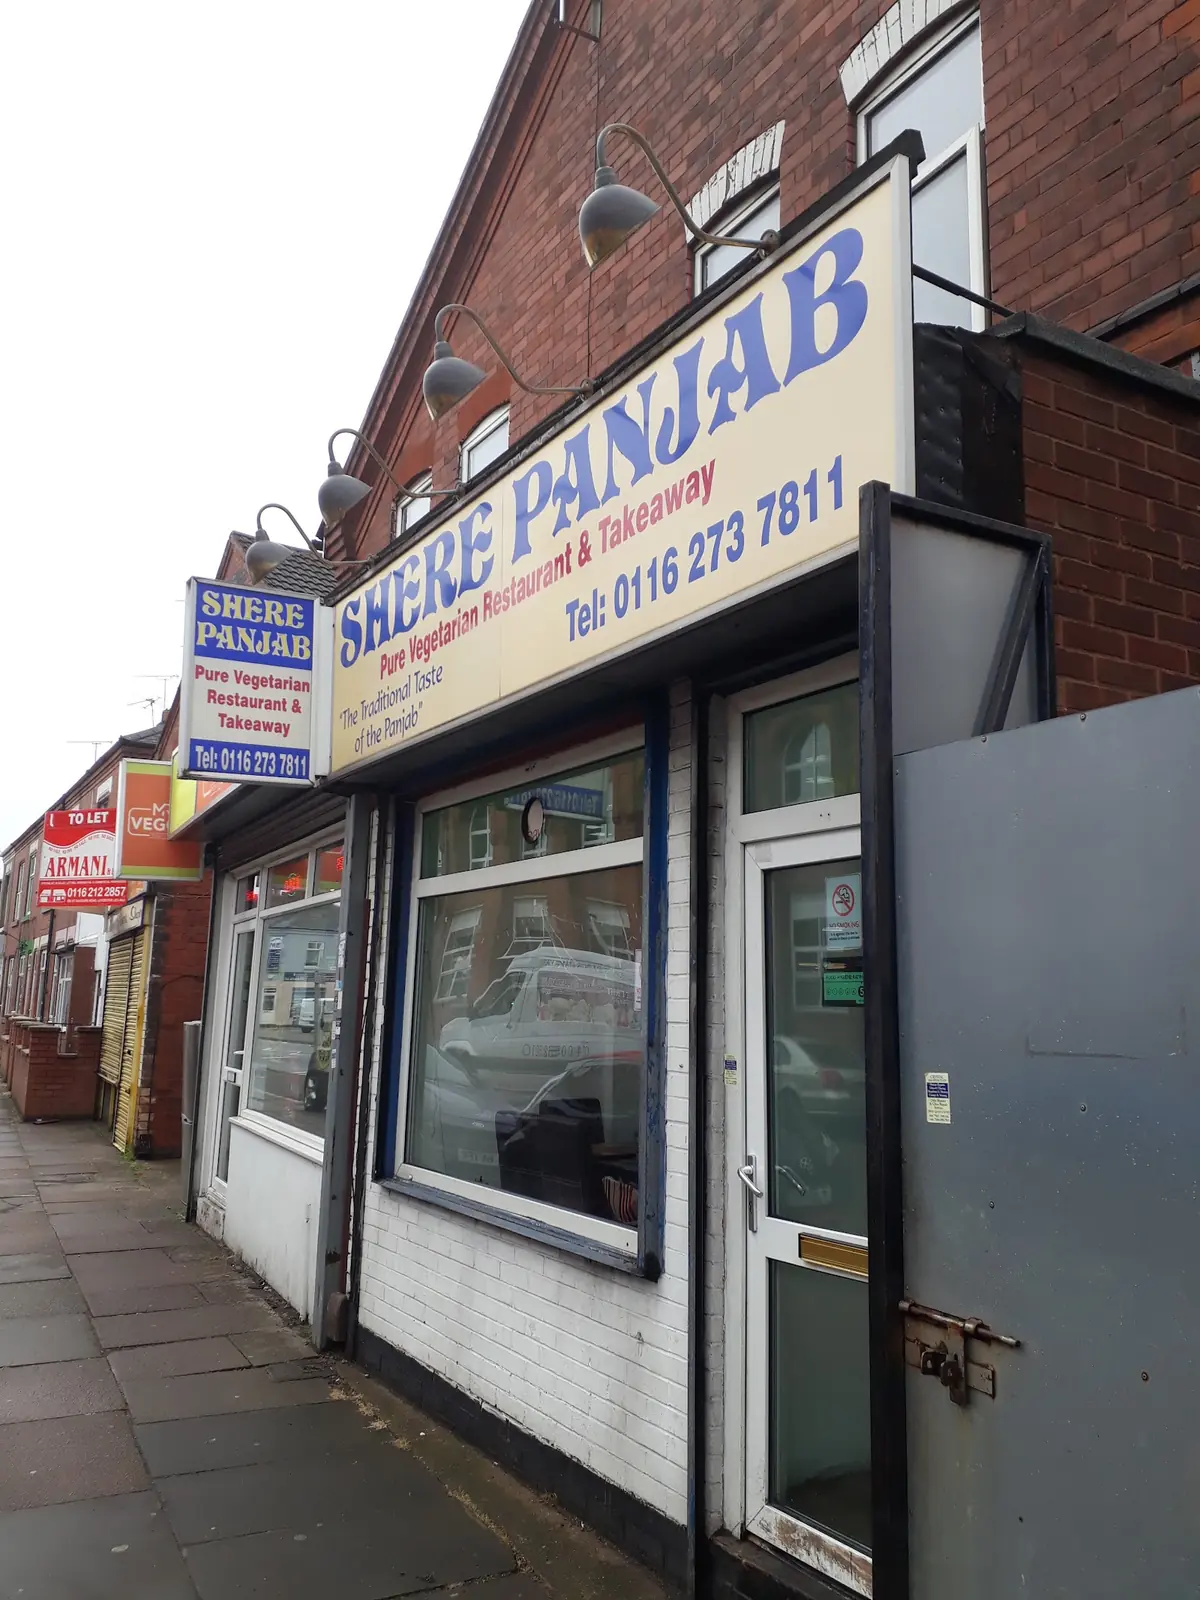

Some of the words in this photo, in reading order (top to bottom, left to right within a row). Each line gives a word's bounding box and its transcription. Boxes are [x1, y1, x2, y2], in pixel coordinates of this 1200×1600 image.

[340, 501, 494, 668] SHERE
[511, 228, 869, 565] PANJAB
[566, 588, 606, 641] Tel:
[613, 545, 679, 619] 0116
[688, 509, 745, 583] 273
[757, 454, 844, 548] 7811
[380, 649, 405, 680] Pure
[409, 607, 478, 663] Vegetarian
[483, 543, 572, 622] Restaurant
[577, 529, 592, 568] &
[599, 458, 716, 554] Takeaway
[202, 590, 305, 629] SHERE
[196, 621, 311, 660] PANJAB
[194, 665, 229, 683] Pure
[234, 670, 310, 693] Vegetarian
[360, 675, 411, 719] Traditional
[414, 665, 443, 693] Taste
[207, 689, 287, 713] Restaurant
[291, 699, 302, 714] &
[218, 713, 290, 737] Takeaway
[354, 731, 365, 753] of
[366, 725, 382, 749] the
[195, 746, 217, 770] Tel:
[221, 749, 250, 773] 0116
[254, 751, 275, 775] 273
[280, 754, 306, 776] 7811
[68, 812, 84, 825] TO
[87, 811, 109, 824] LET
[131, 816, 169, 831] VEG
[45, 855, 107, 877] ARMANI
[67, 887, 87, 897] 0116
[88, 887, 103, 896] 212
[104, 886, 126, 896] 2857
